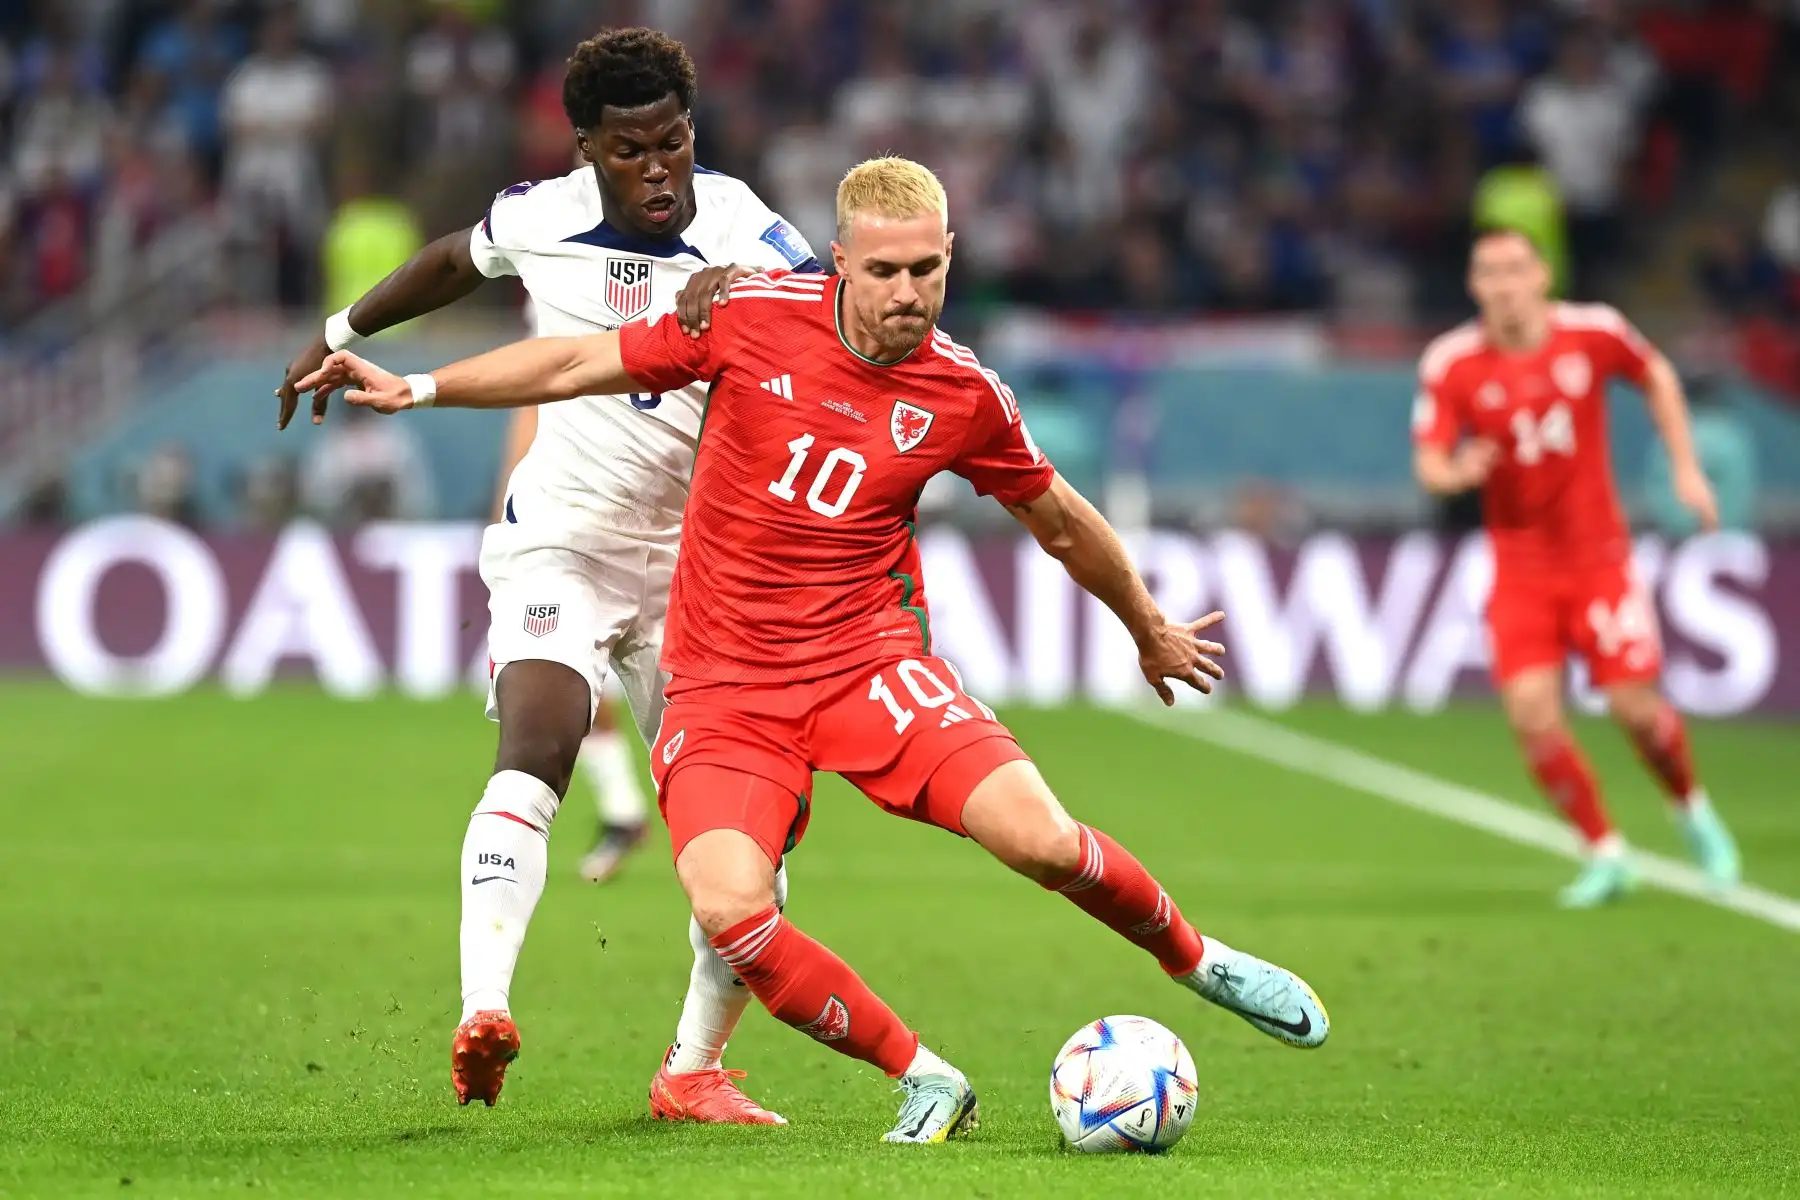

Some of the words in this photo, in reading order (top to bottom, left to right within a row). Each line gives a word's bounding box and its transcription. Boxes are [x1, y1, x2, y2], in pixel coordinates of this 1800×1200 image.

[610, 261, 649, 285] USA
[1511, 403, 1577, 465] 14
[767, 432, 868, 518] 10
[528, 606, 557, 618] USA
[922, 527, 1776, 714] AIRWAS
[868, 659, 956, 735] 10
[478, 853, 515, 870] USA
